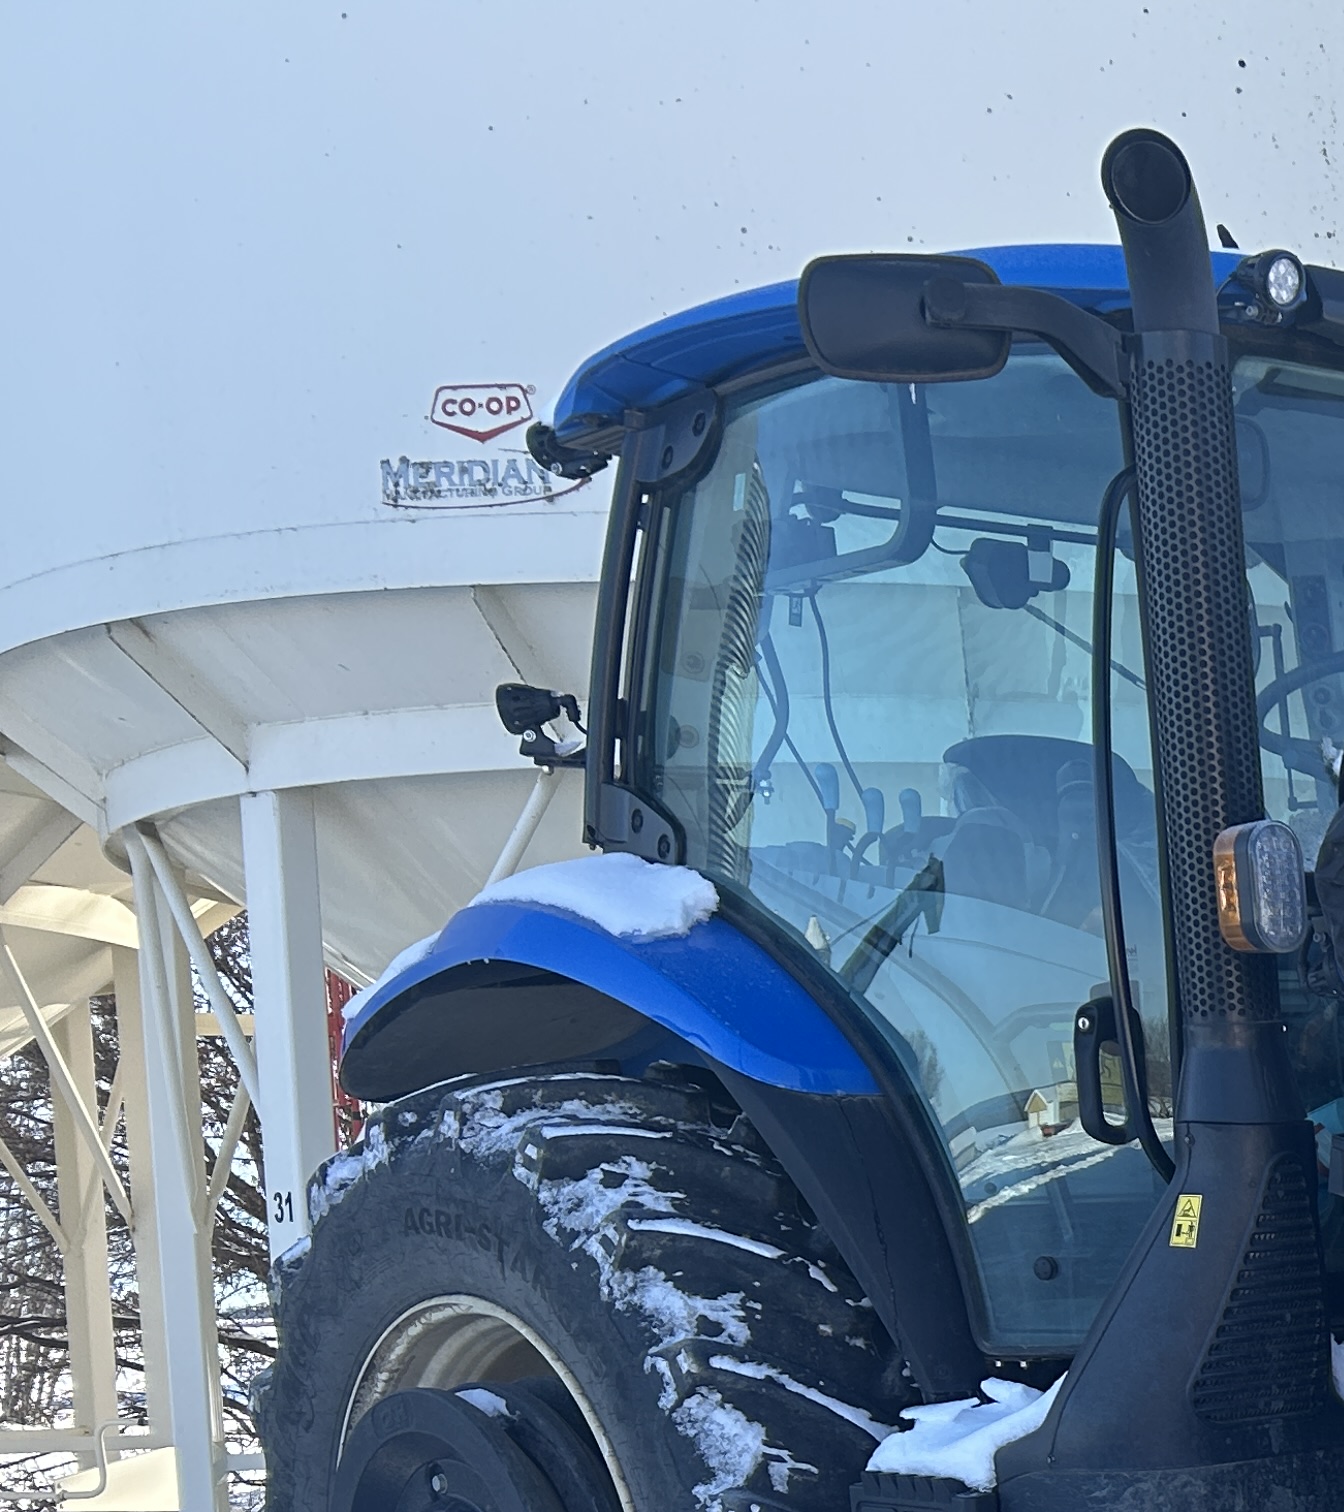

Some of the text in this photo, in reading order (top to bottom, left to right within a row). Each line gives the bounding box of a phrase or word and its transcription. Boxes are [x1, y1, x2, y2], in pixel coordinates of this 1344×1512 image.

[441, 396, 521, 417] CO-OP
[380, 456, 552, 491] MERIDIAN
[274, 1191, 294, 1223] 31
